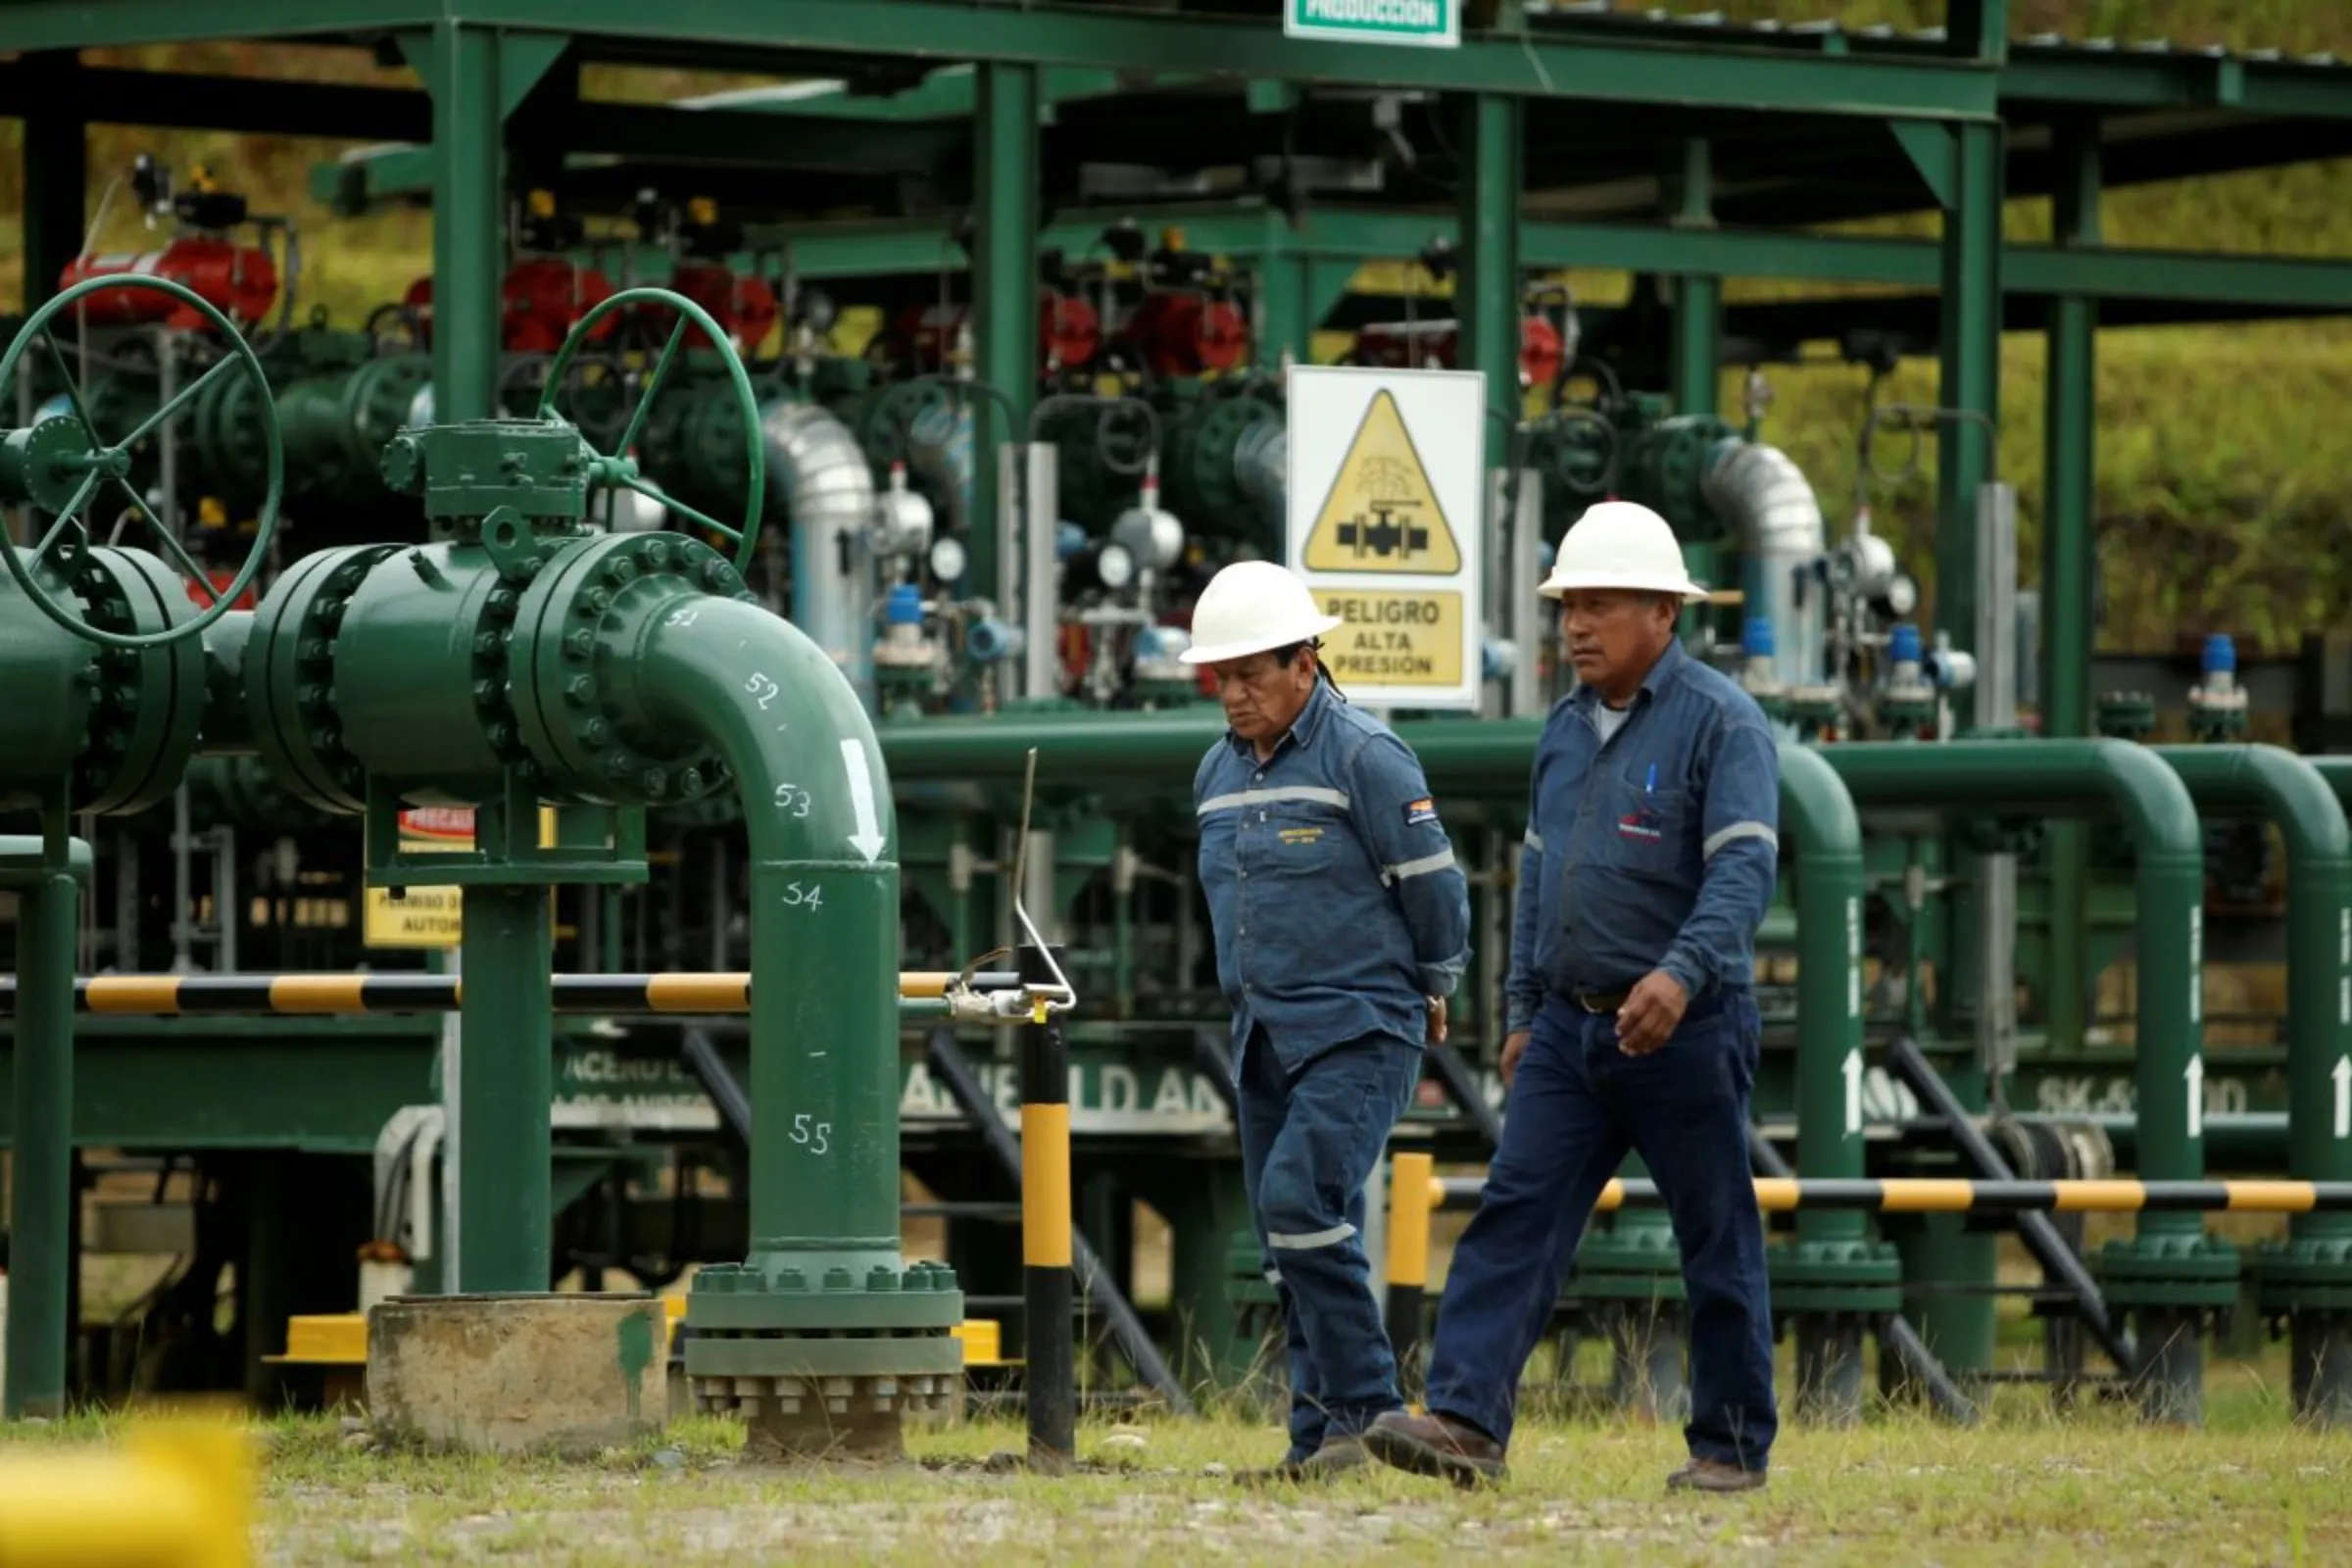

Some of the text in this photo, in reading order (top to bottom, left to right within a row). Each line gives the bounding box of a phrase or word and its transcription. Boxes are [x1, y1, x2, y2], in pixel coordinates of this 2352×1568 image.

[1327, 598, 1440, 624] PELIGRO
[1353, 631, 1412, 651] ALTA
[745, 671, 780, 710] 52
[775, 783, 811, 817] 53
[783, 881, 824, 912] 54
[789, 1113, 831, 1155] 55
